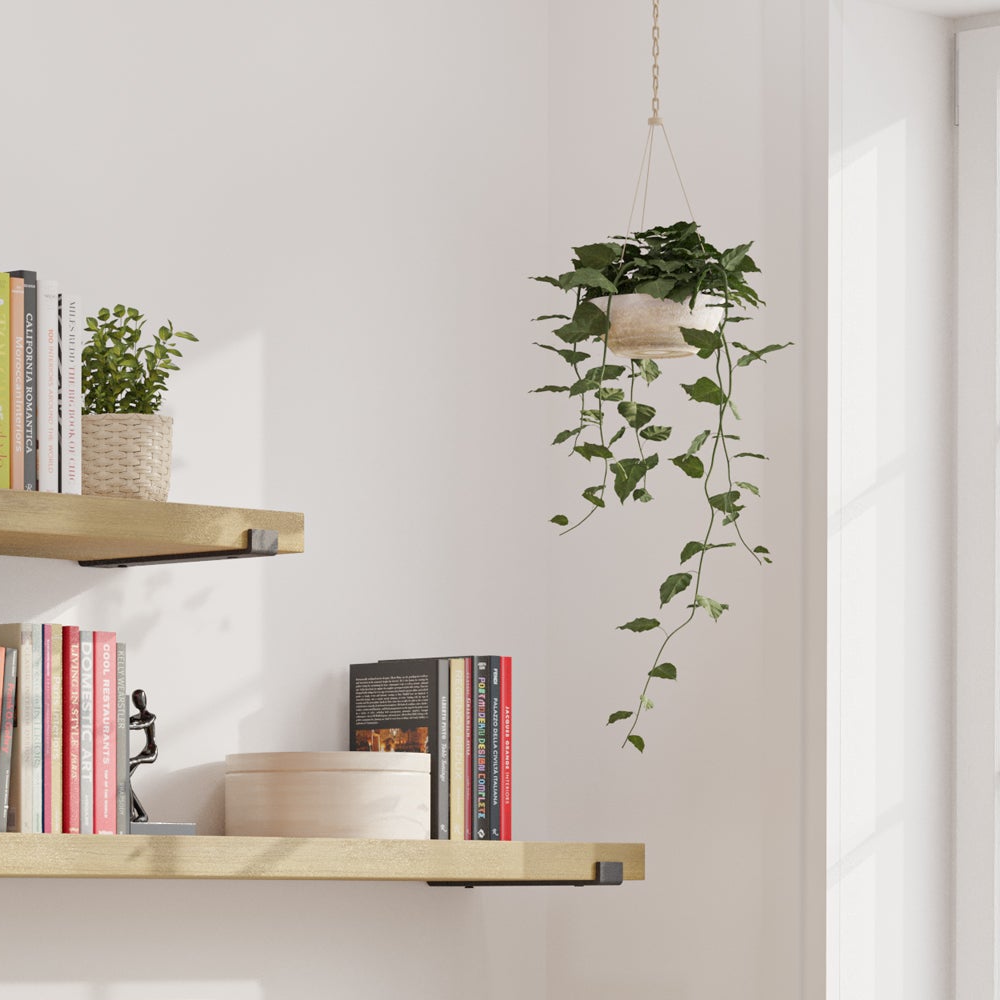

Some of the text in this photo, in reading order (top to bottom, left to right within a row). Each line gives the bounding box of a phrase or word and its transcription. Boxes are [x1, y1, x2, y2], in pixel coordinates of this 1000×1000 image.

[15, 336, 24, 453] Moroccan Interiors
[25, 312, 33, 454] CALIFORNIA ROMANTICA
[71, 644, 79, 689] LIVING
[6, 683, 15, 710] Frank
[71, 691, 79, 706] IN
[81, 641, 92, 741] DOMESTIC
[117, 650, 125, 729] KELLY WEARSTLER
[454, 669, 463, 731] REGENCY
[477, 677, 486, 736] POSTMODERN
[1, 721, 12, 753] Gehry
[52, 676, 61, 760] Paris Interiors
[71, 707, 79, 746] STYLE
[81, 749, 92, 783] ART
[454, 735, 463, 780] REDUX
[477, 738, 486, 771] DESIGN
[477, 773, 486, 819] COMPLETE
